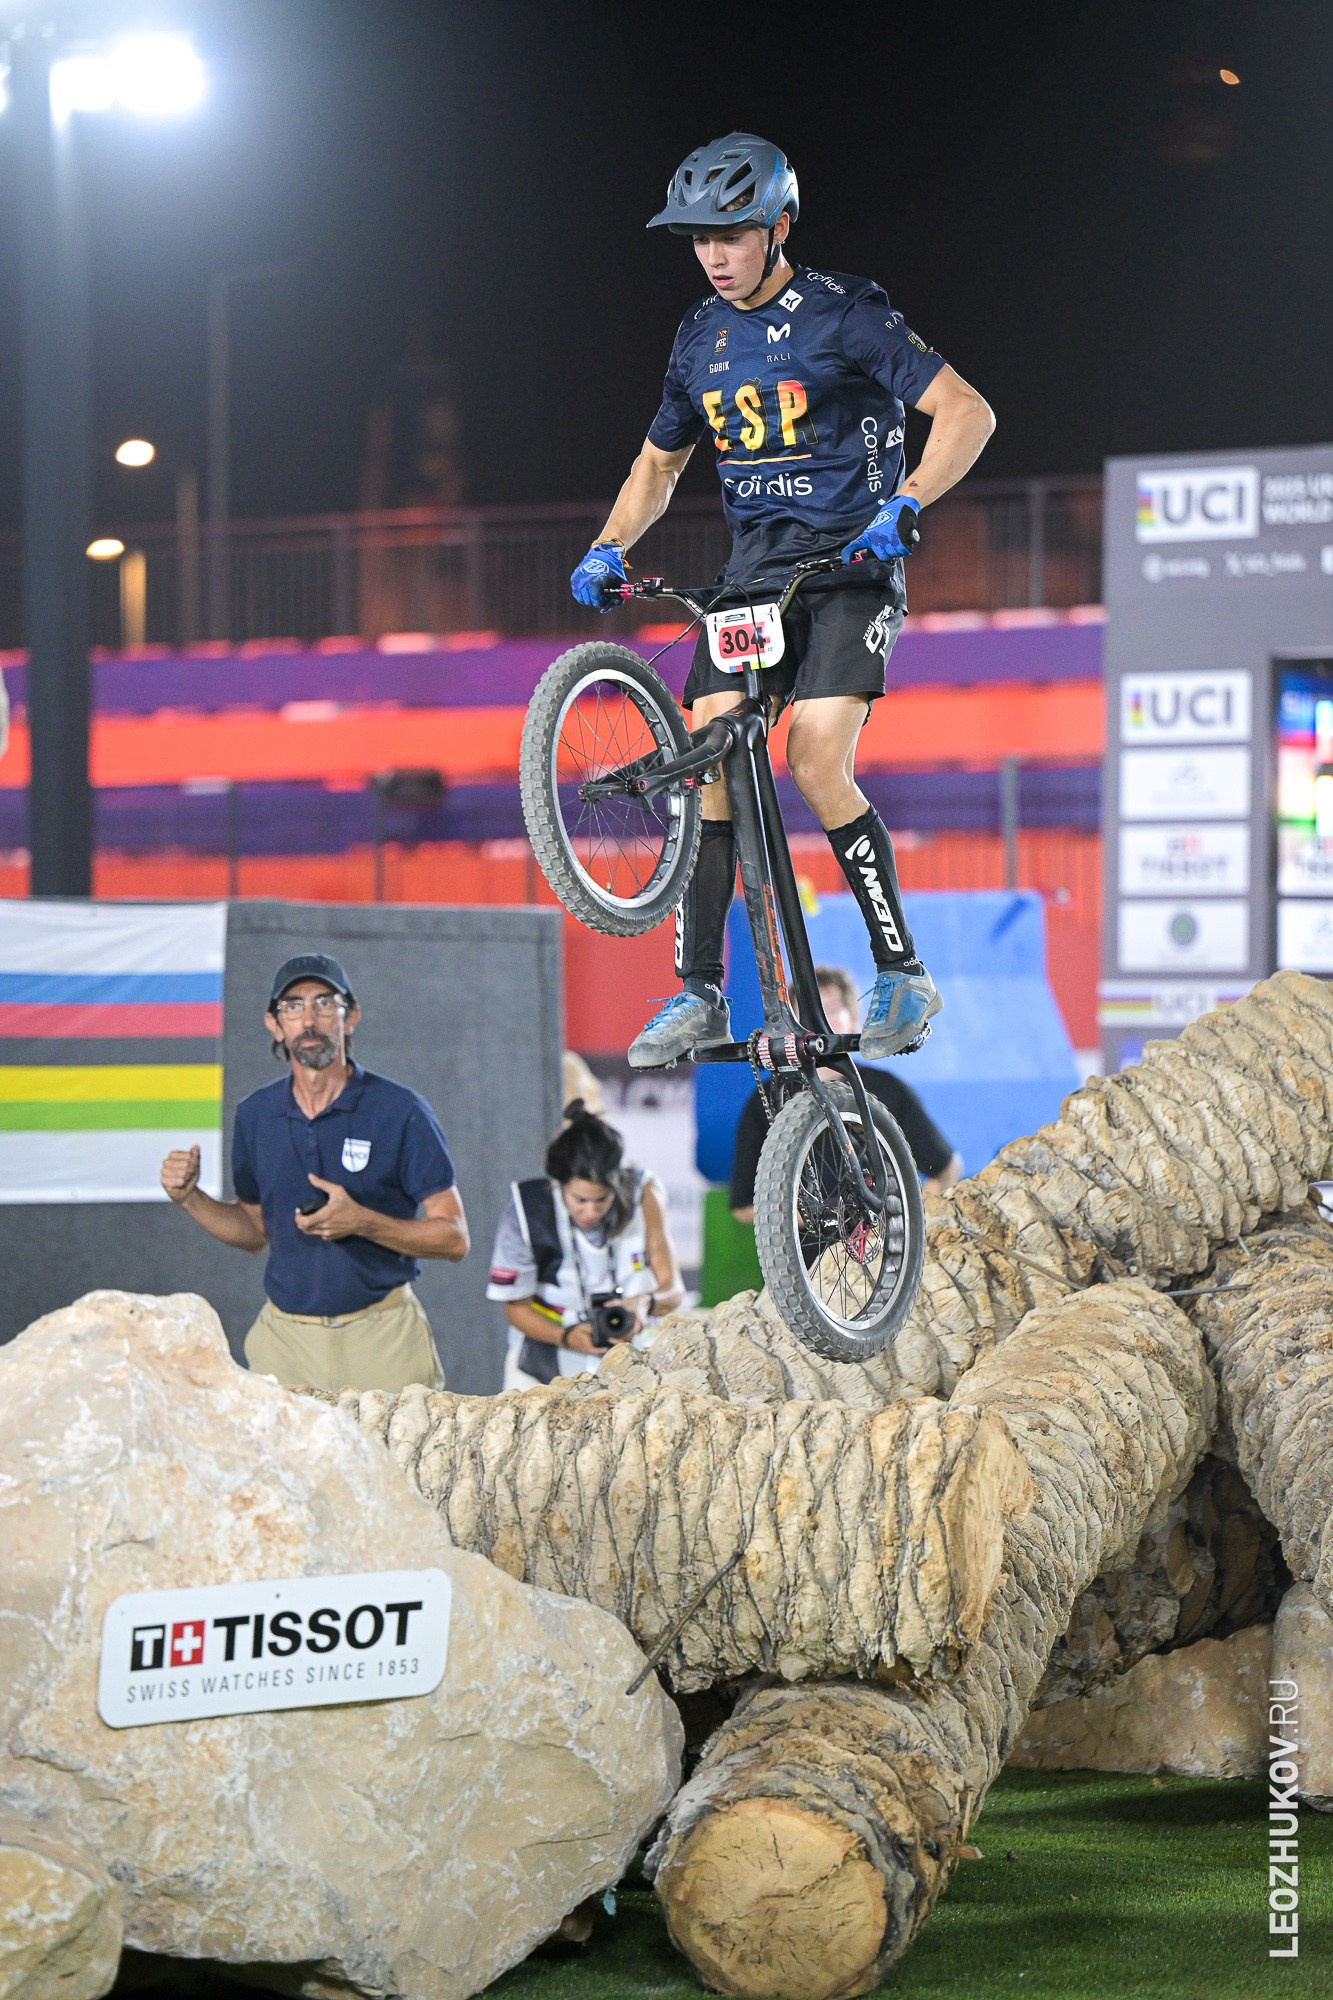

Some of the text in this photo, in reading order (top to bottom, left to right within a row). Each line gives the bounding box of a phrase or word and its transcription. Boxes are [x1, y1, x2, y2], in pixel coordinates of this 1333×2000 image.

[806, 272, 846, 294] Cofidis
[702, 380, 808, 452] ESP
[860, 416, 882, 493] Cofidis
[1163, 483, 1245, 525] UCI
[722, 626, 767, 655] 304
[1151, 688, 1234, 728] UCI
[858, 866, 904, 952] CLEAN
[213, 1601, 423, 1662] TISSOT
[127, 1658, 419, 1703] SWISS WATCHES SINCE 1853
